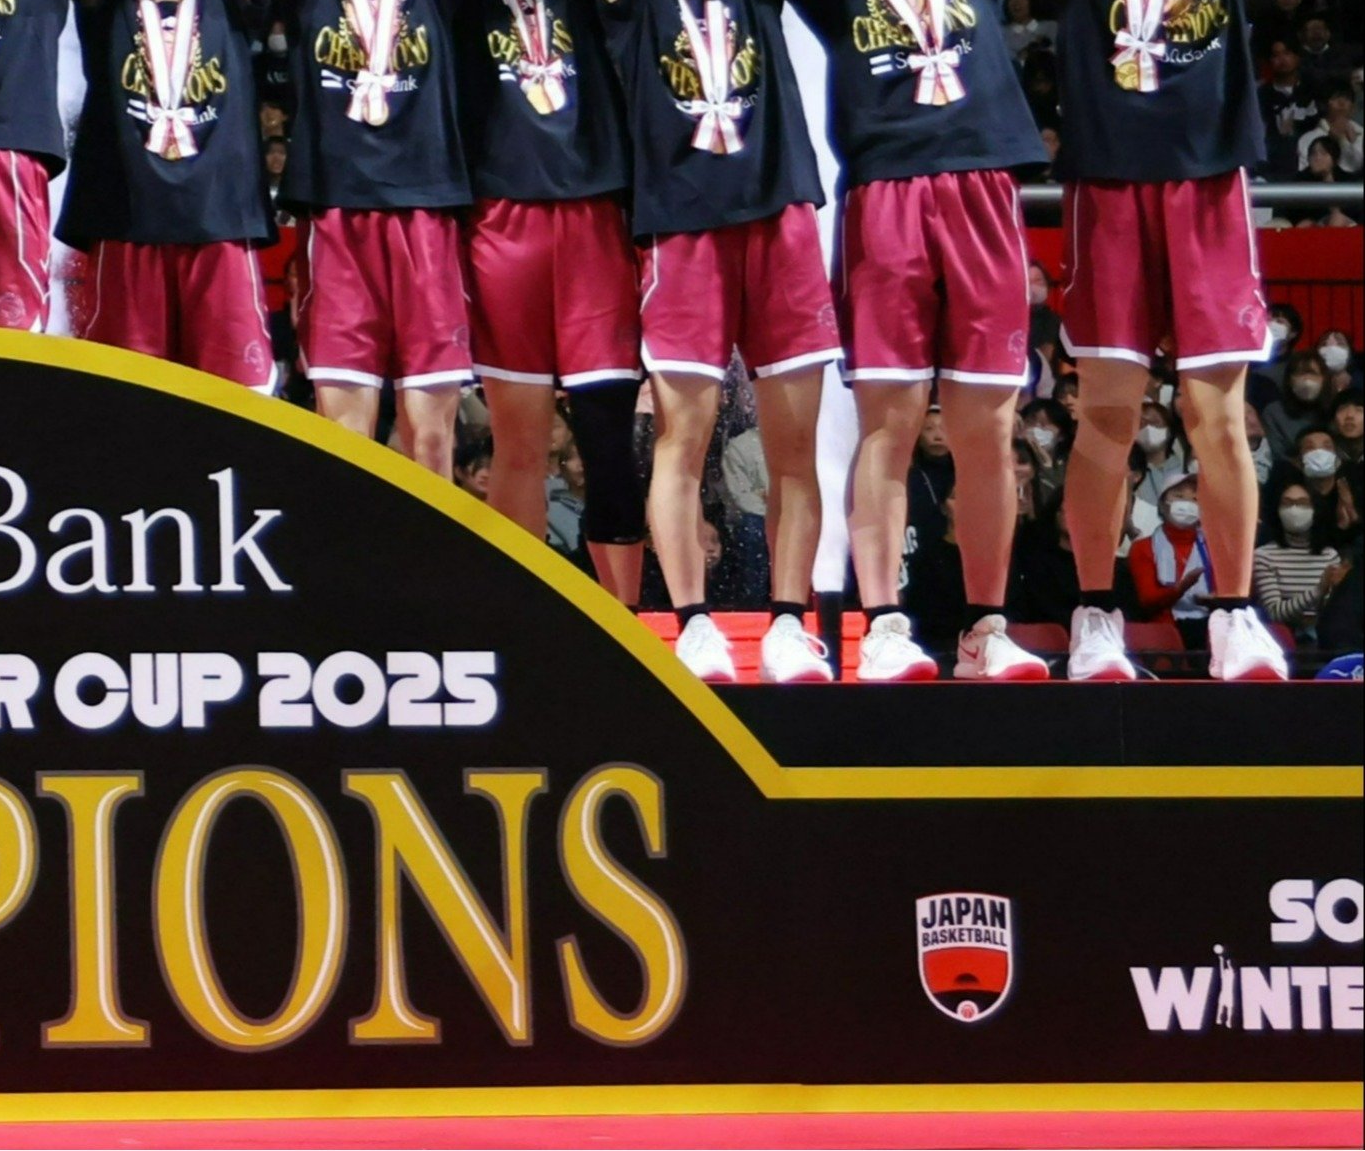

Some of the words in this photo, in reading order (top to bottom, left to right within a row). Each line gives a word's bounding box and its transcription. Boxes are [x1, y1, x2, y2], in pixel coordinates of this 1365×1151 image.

[54, 652, 245, 730] CUP
[257, 650, 499, 728] 2025
[921, 896, 1008, 931] JAPAN
[922, 927, 1008, 948] BASKETBALL
